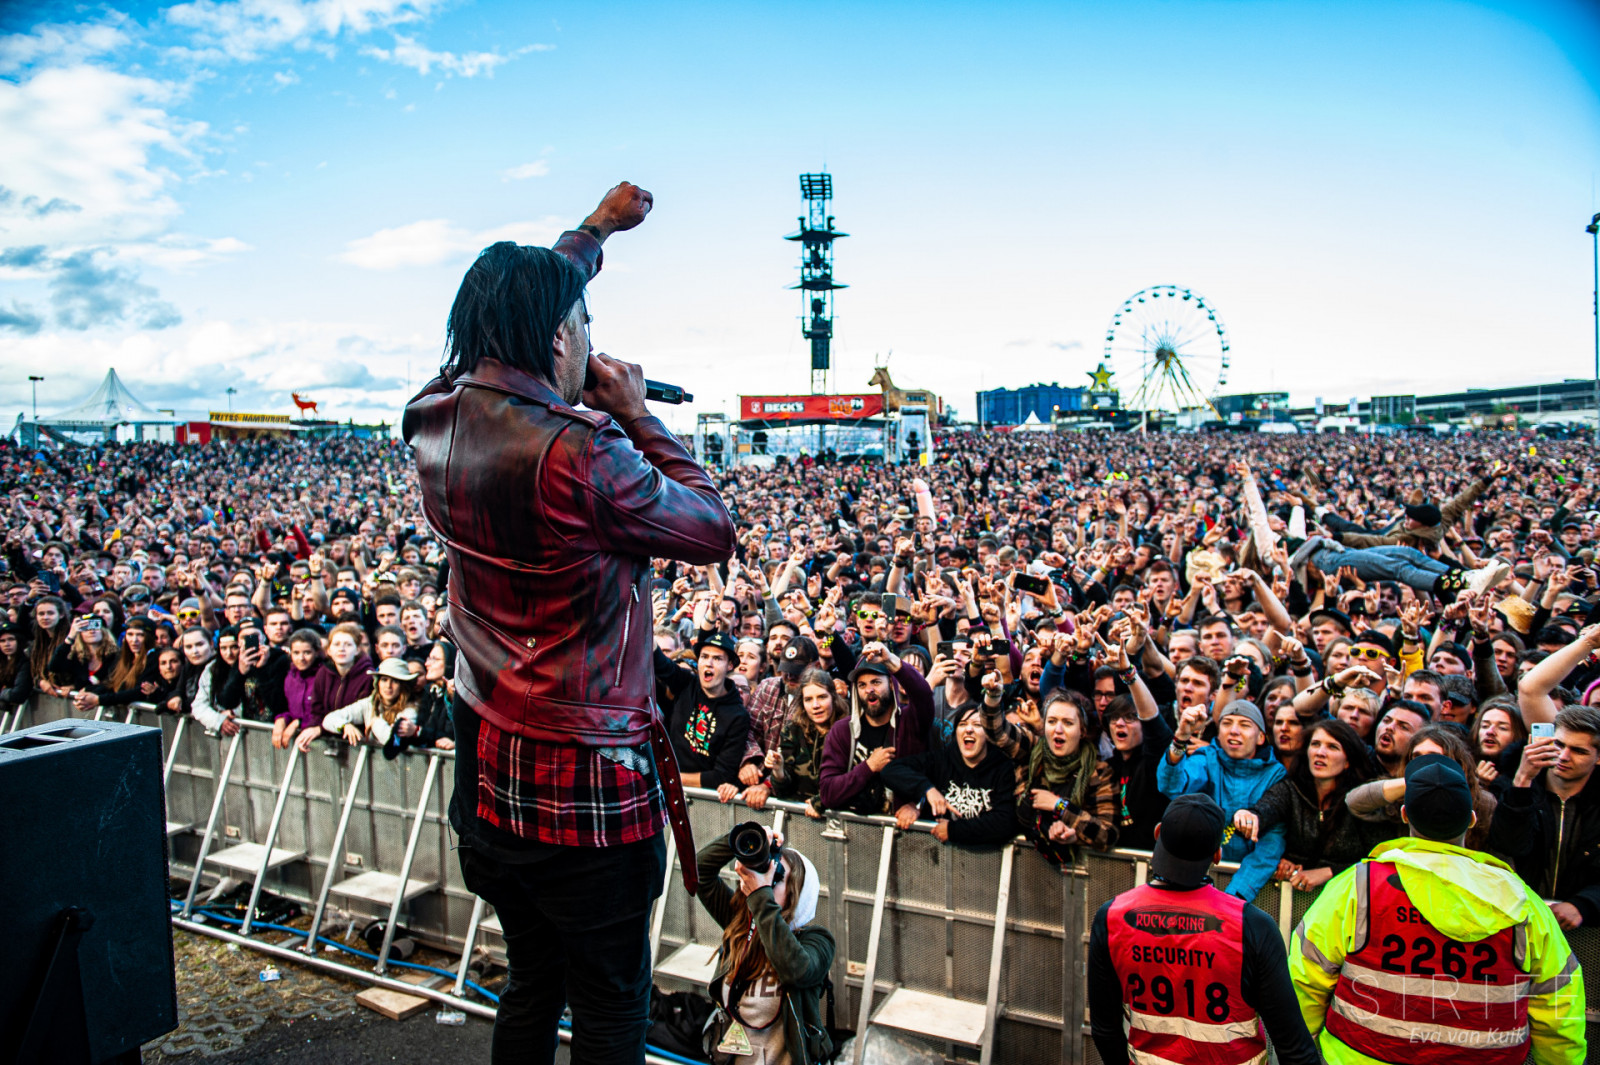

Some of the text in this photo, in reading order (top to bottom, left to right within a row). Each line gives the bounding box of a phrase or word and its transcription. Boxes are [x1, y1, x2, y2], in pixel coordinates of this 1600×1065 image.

[1136, 913, 1167, 929] ROCK
[1178, 916, 1206, 932] RING
[1132, 945, 1215, 969] SECURITY
[1381, 934, 1498, 983] 2262
[1127, 973, 1231, 1023] 2918
